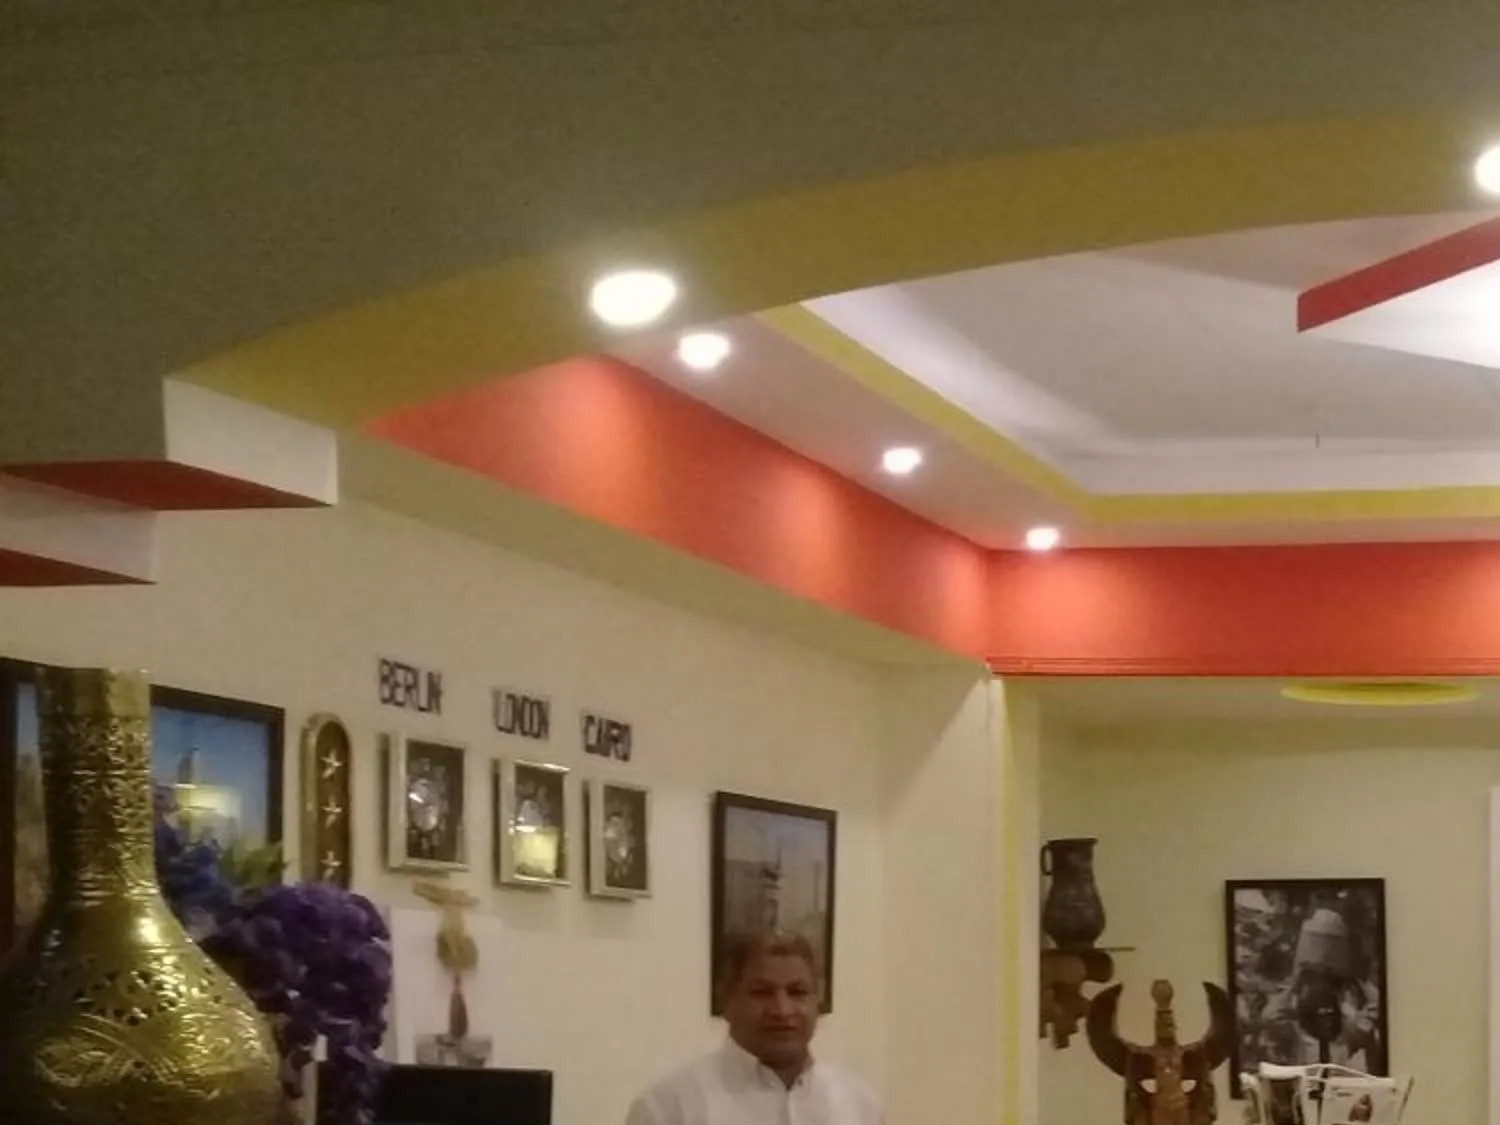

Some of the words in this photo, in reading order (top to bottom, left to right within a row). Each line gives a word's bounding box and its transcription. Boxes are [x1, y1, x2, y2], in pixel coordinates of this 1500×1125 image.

[379, 658, 442, 716] BERLIN
[492, 689, 550, 741] LONDON
[583, 714, 632, 763] CAIRO
